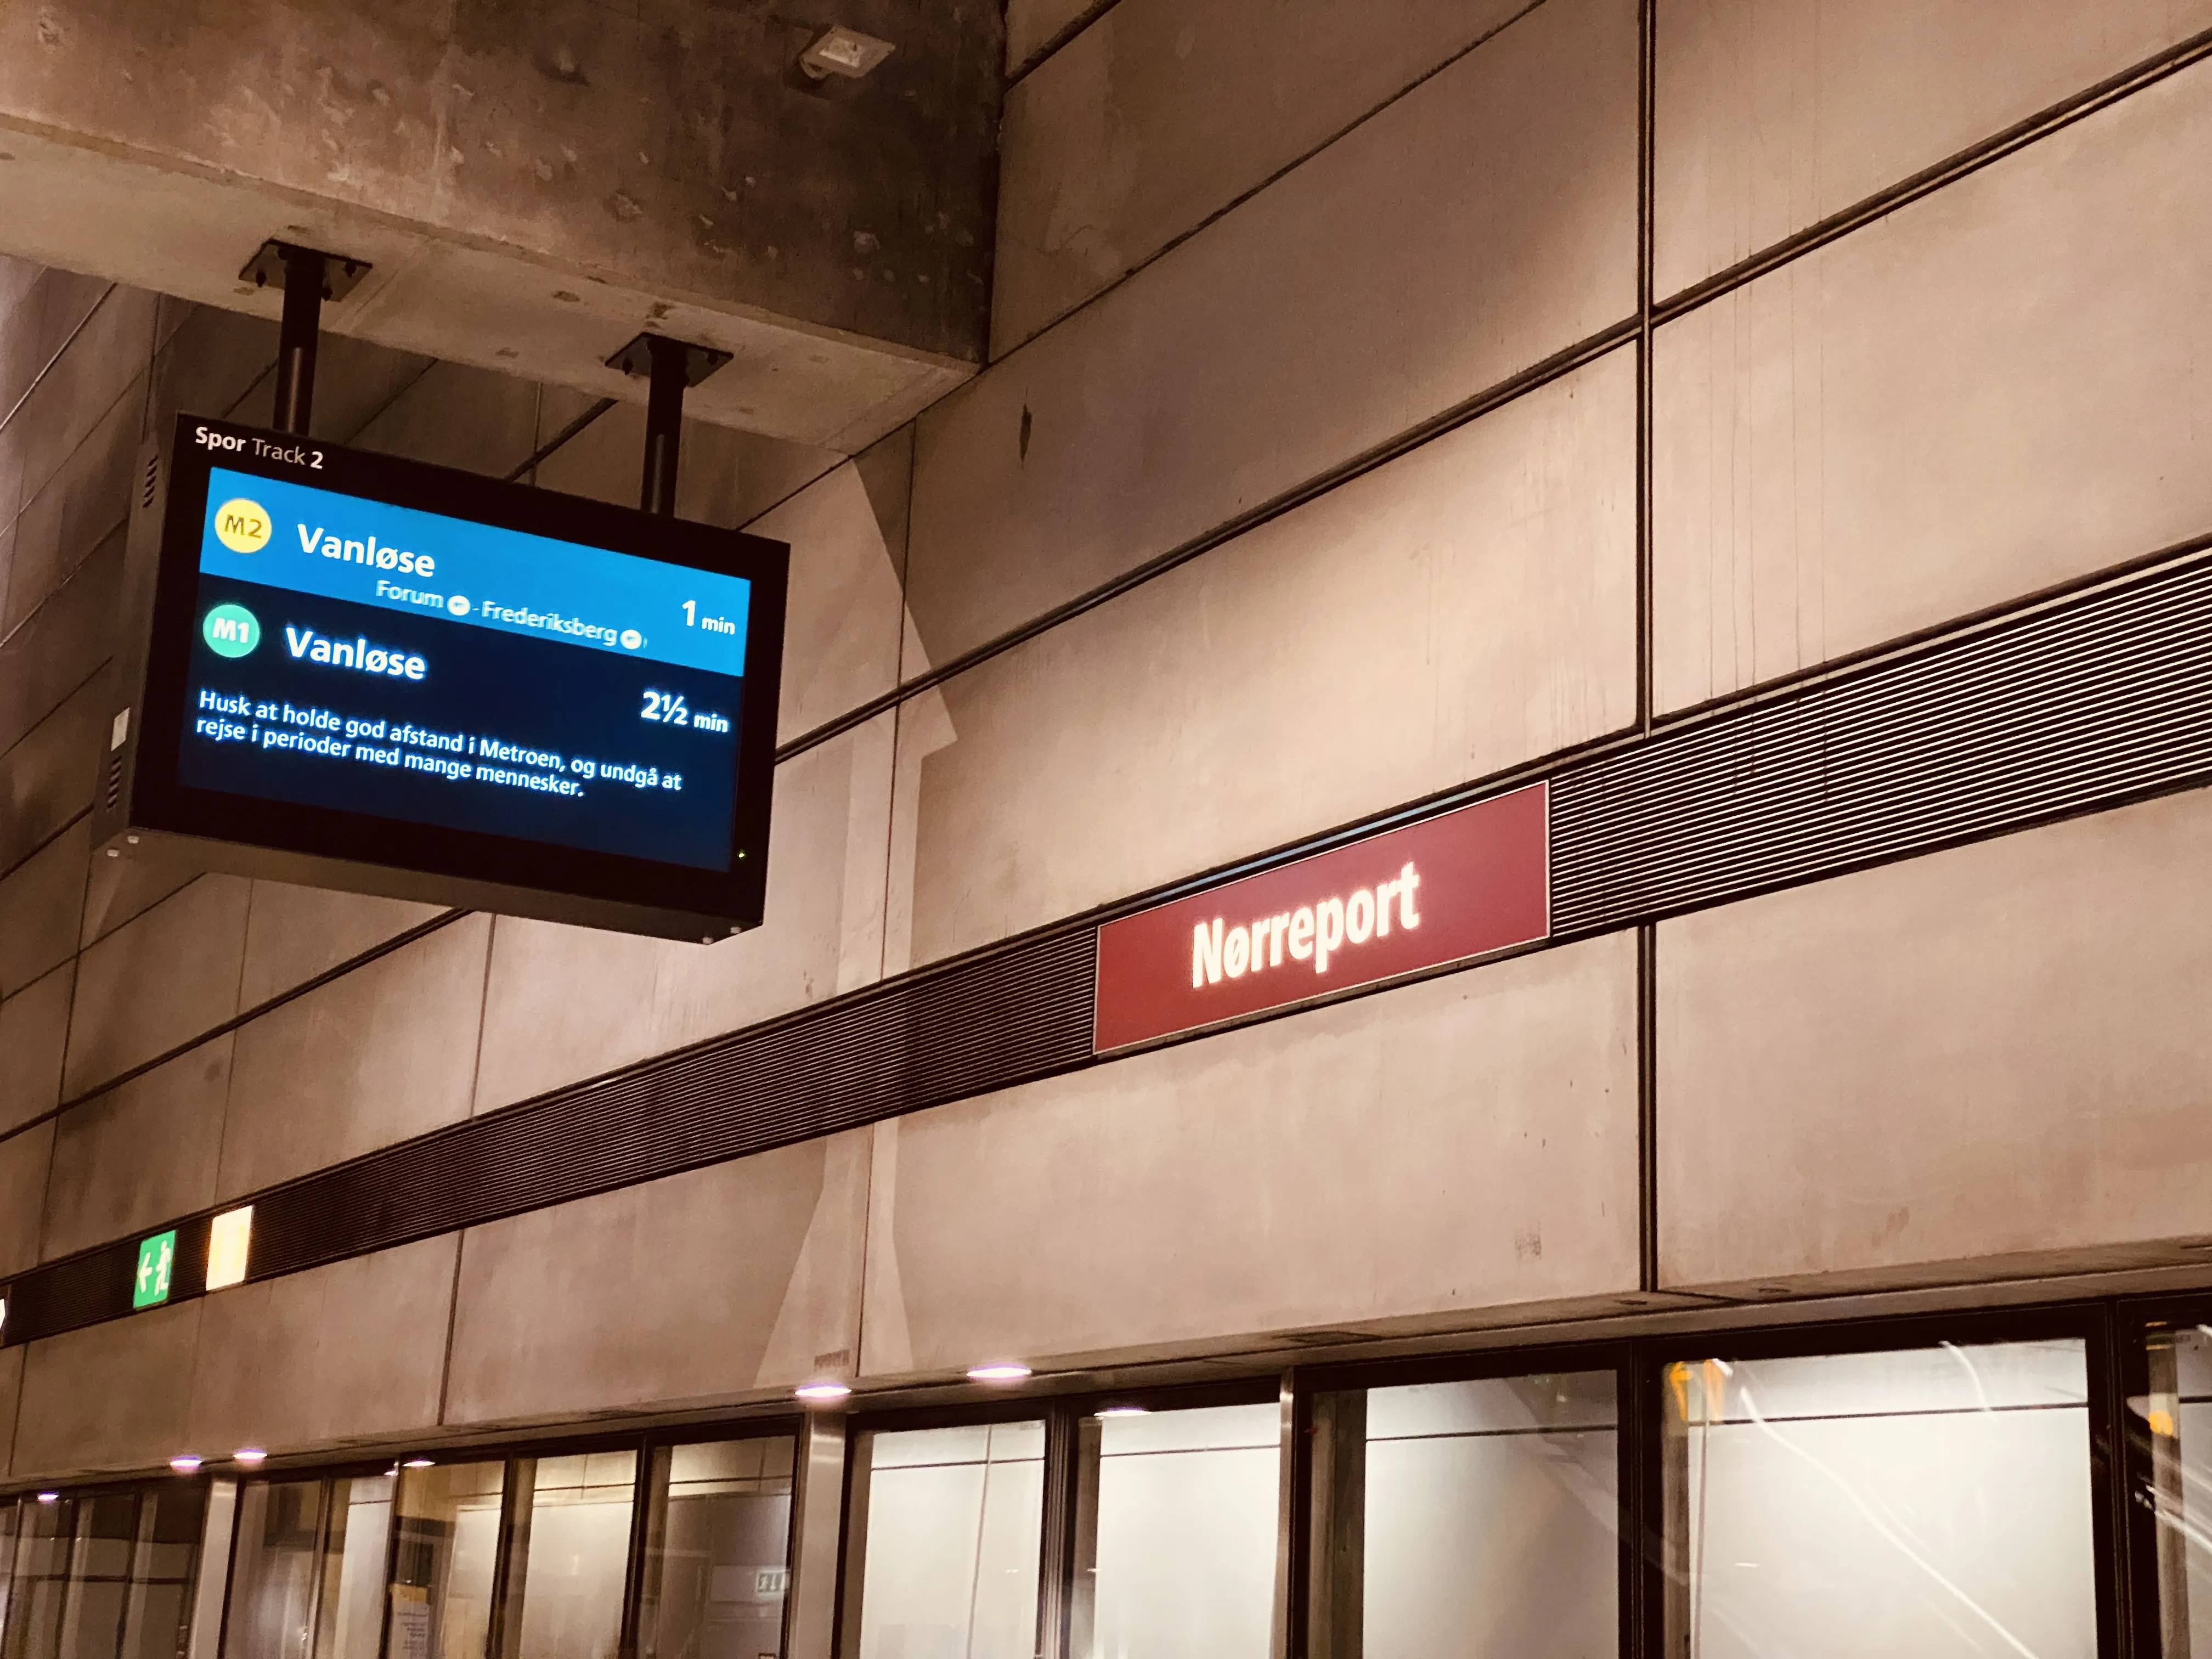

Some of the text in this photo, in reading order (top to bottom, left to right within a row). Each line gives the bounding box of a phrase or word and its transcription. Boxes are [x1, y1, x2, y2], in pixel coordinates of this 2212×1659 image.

[195, 426, 324, 469] Spor Track 2
[224, 515, 262, 539] M2
[297, 523, 435, 577] Vanløse
[213, 617, 249, 643] M1
[376, 580, 443, 608] Forum
[482, 601, 617, 646] Frederiksberg
[681, 600, 735, 635] 1 min
[285, 627, 426, 679] Vanløse
[199, 690, 682, 791] Husk at holde god afstand i Metroen, og undgå at
[694, 713, 729, 733] min
[196, 719, 584, 797] rejse i perioder med mange mennesker.
[1191, 861, 1421, 989] Nørreport
